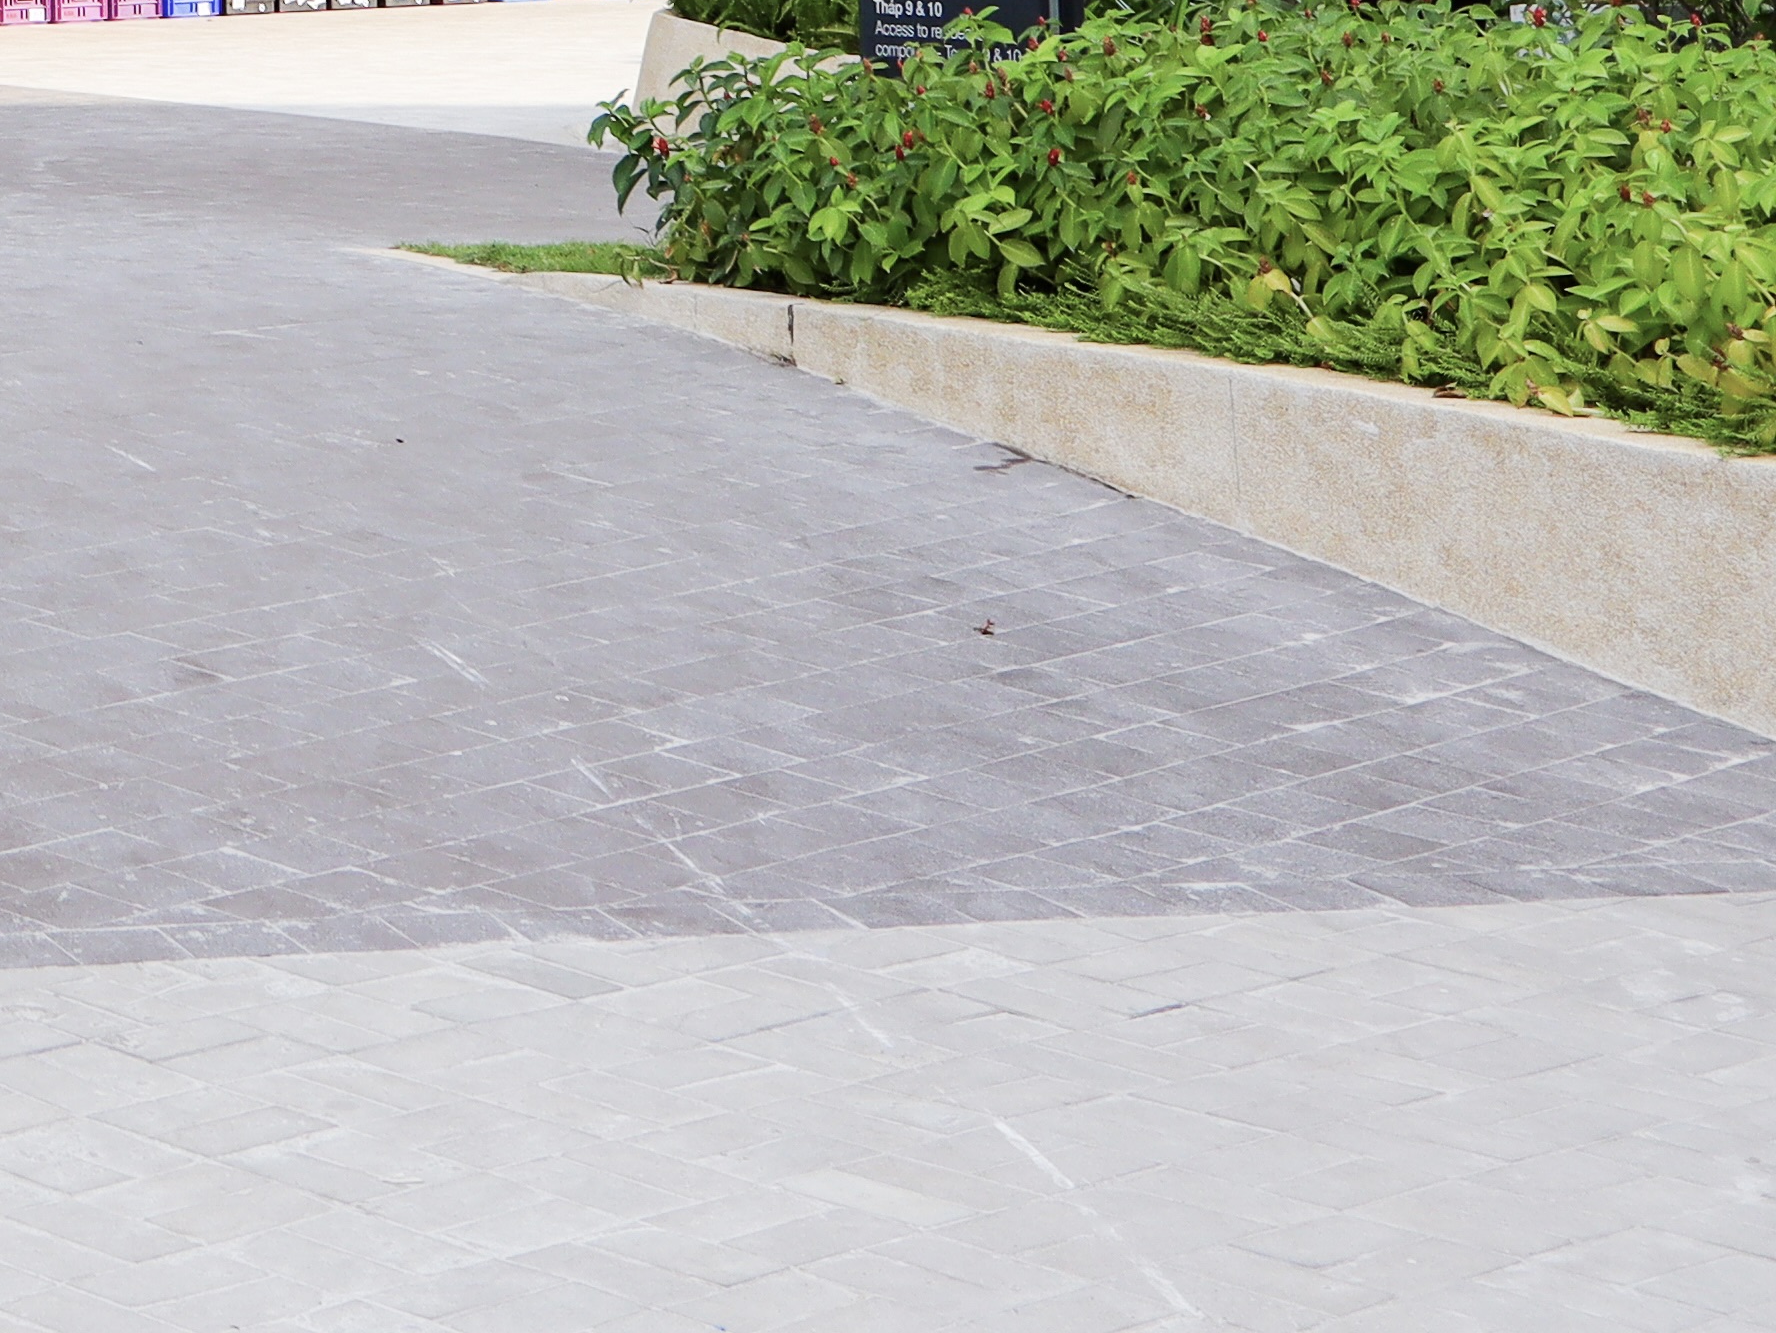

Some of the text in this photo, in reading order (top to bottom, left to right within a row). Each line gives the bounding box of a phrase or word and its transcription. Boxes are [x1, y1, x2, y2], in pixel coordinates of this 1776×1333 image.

[873, 0, 943, 18] Tháp 9 & 10
[875, 20, 915, 37] Access
[917, 23, 928, 38] to
[875, 44, 915, 61] compo
